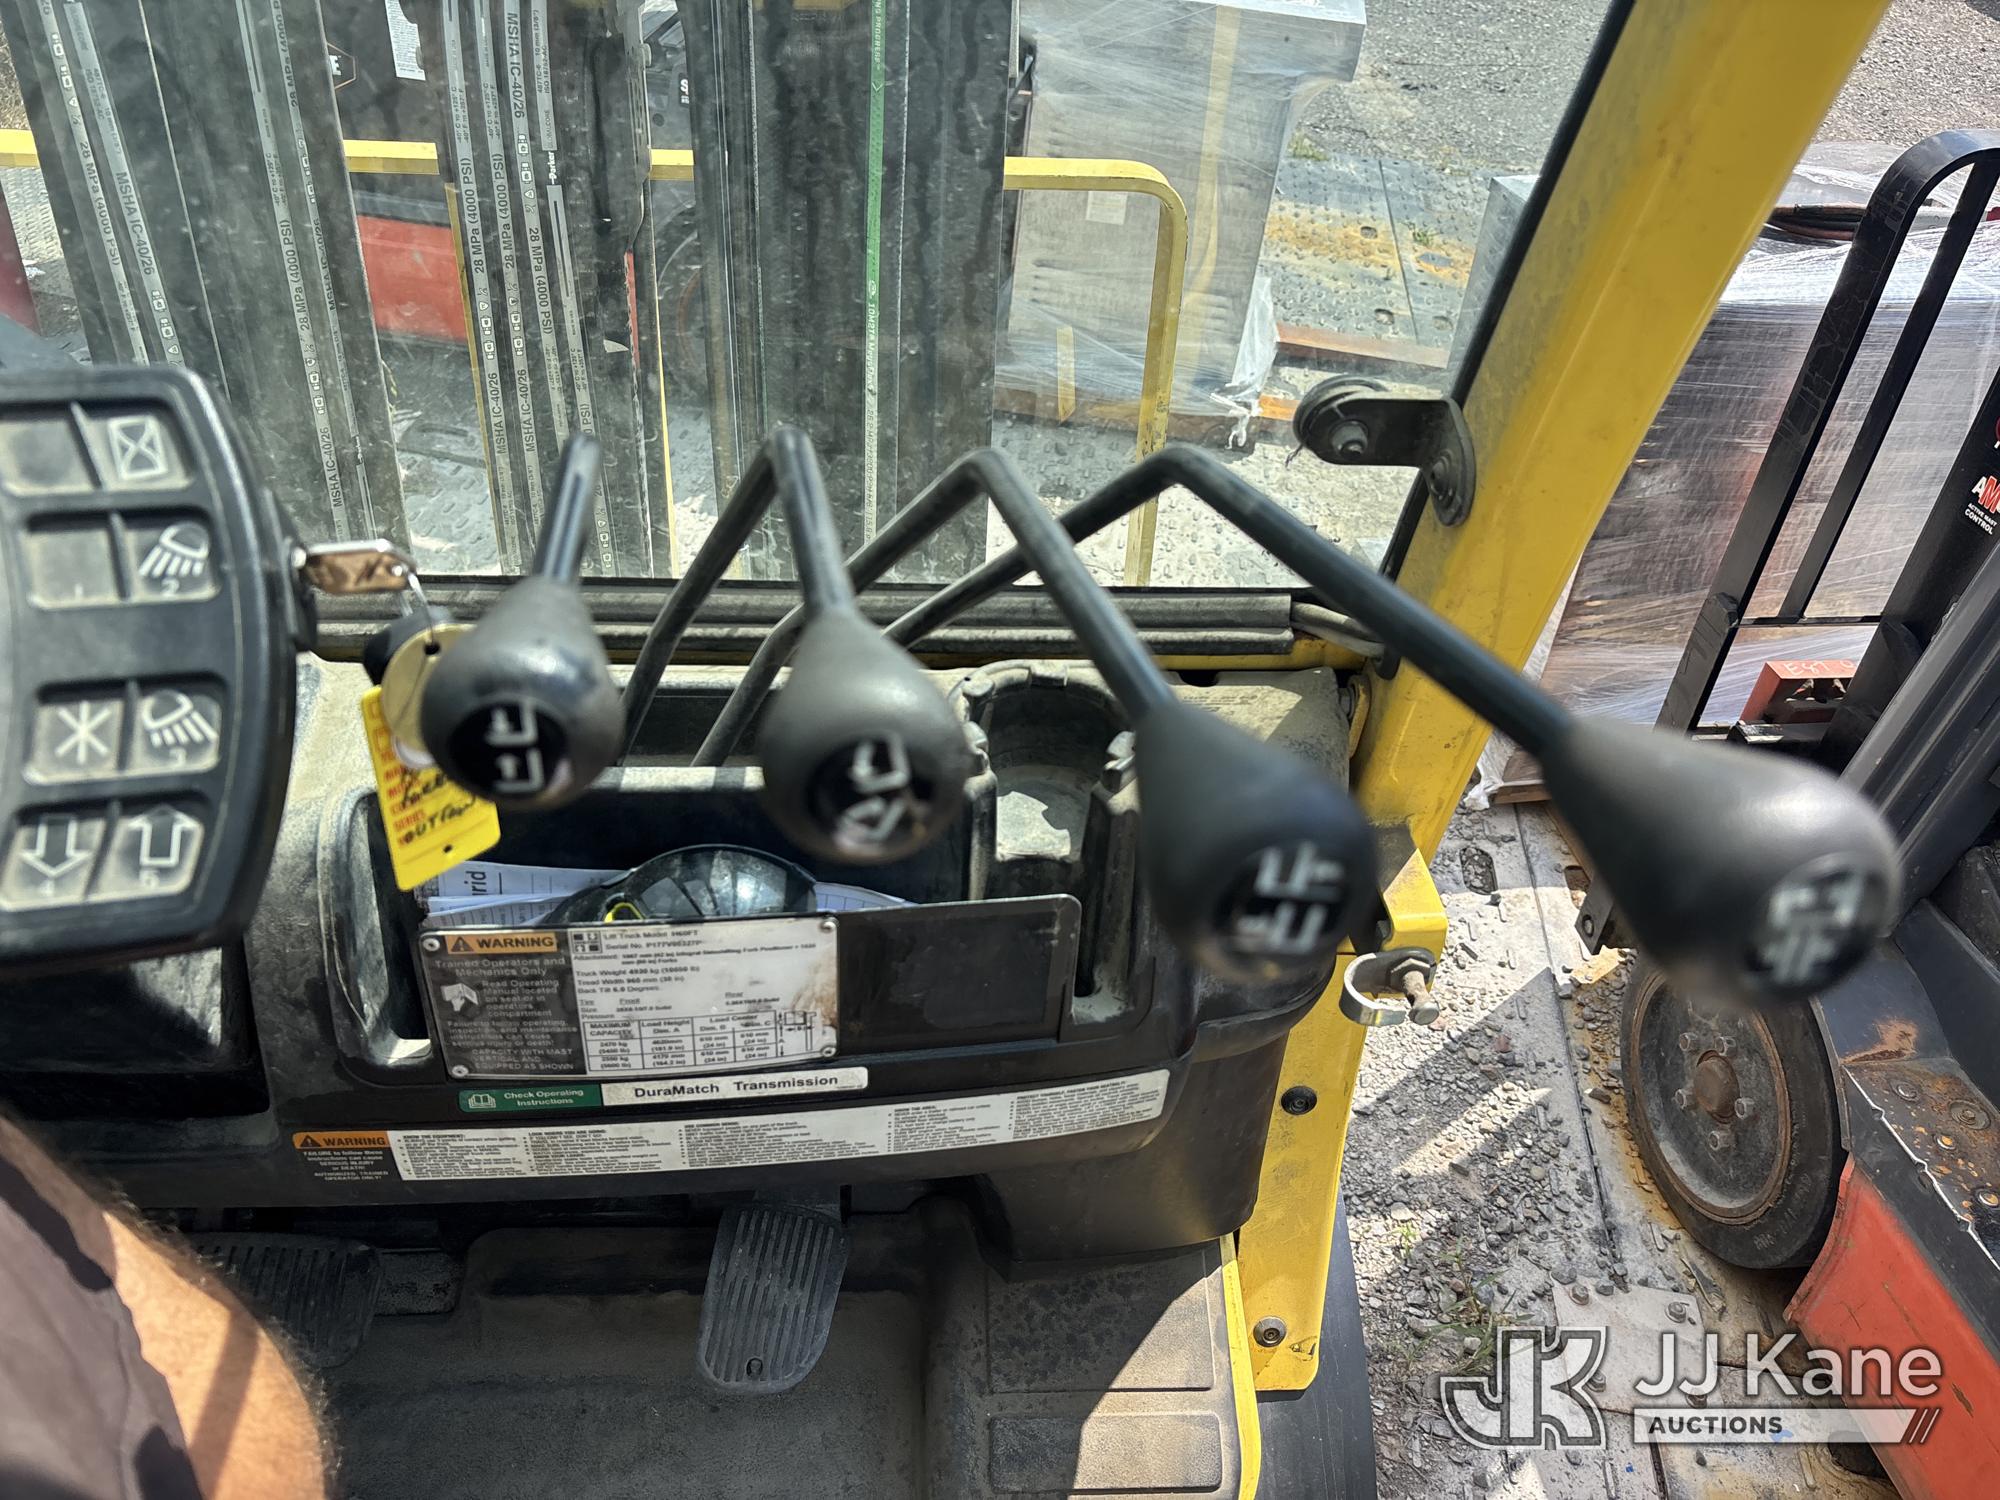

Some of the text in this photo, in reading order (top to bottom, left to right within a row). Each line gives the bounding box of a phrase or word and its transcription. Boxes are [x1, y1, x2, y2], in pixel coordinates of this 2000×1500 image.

[507, 12, 526, 119] MSHA IC-40/26
[460, 157, 473, 185] PSI)
[492, 153, 505, 180] PSI)
[465, 189, 479, 224] (4000
[496, 184, 510, 219] (4000
[116, 172, 155, 276] MSHA IC-40/26
[502, 223, 513, 250] MPa
[470, 228, 482, 256] MPa
[280, 219, 311, 331] 28 MPa (4000 PSI)
[474, 259, 485, 274] 28
[505, 254, 515, 269] 28
[529, 227, 553, 334] 28 MPa (4000 PSI)
[488, 372, 507, 454] MSHA IC-40/26
[516, 369, 536, 452] MSHA IC-40/26
[320, 427, 336, 471] IC-40/26
[329, 475, 343, 507] MSHA
[1965, 508, 1993, 535] CONTROL
[476, 936, 554, 949] WARNING
[435, 957, 566, 968] Trained Operators and
[455, 967, 547, 977] Mechanics Only
[504, 1088, 584, 1100] Check Operating
[634, 1075, 838, 1098] DuraMatch Transmission
[517, 1097, 574, 1107] Instructions
[322, 1136, 386, 1146] WARNING
